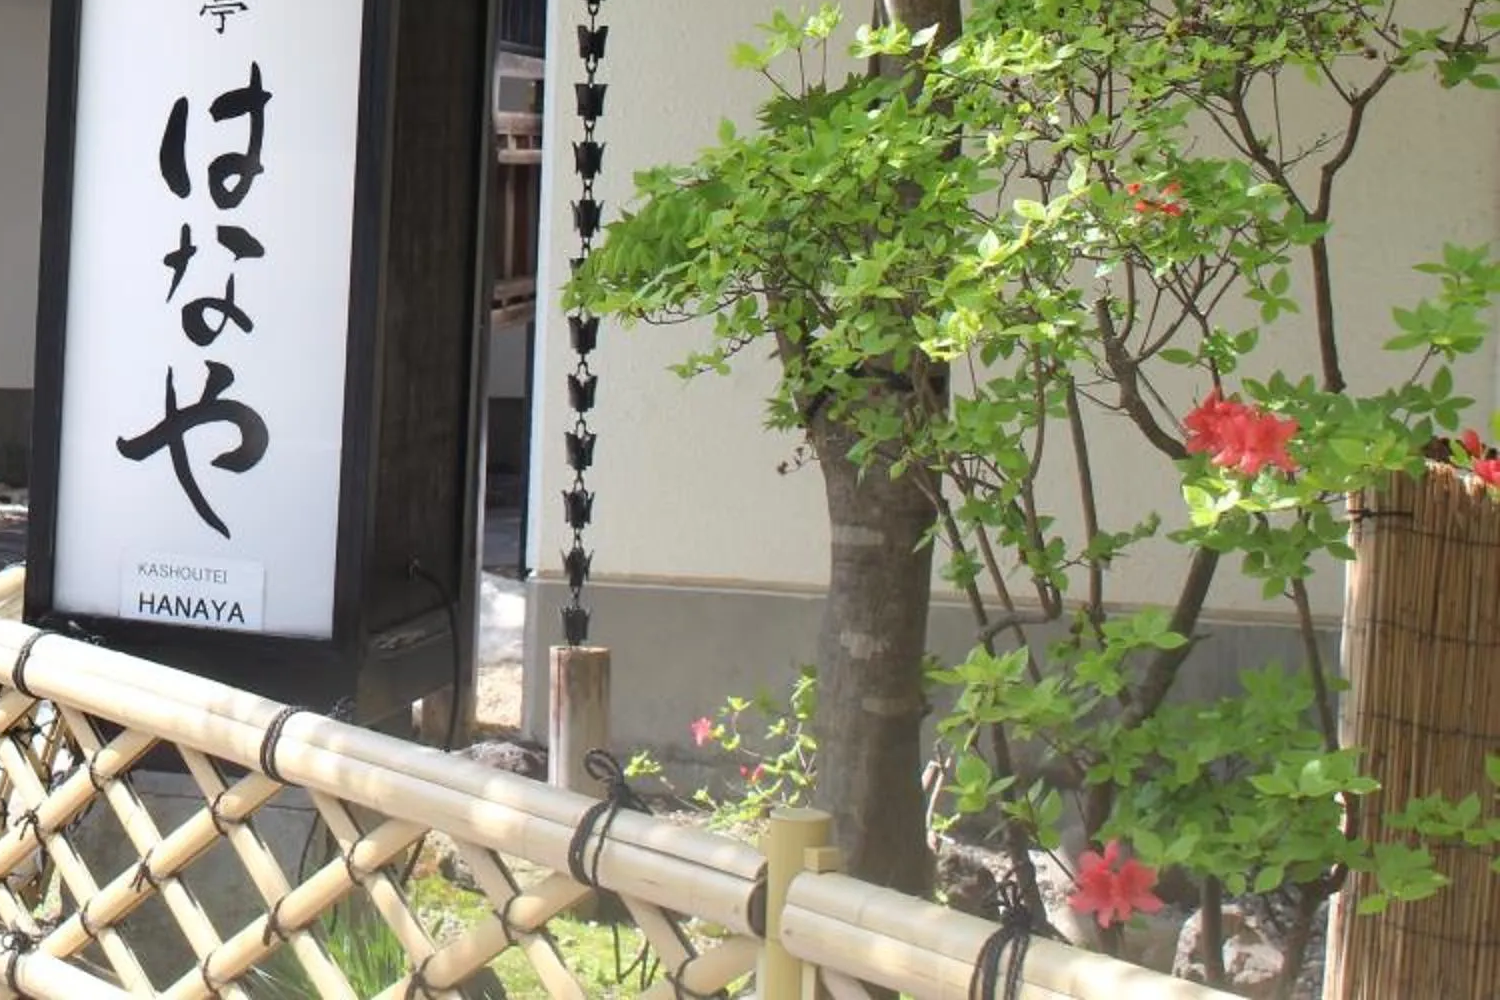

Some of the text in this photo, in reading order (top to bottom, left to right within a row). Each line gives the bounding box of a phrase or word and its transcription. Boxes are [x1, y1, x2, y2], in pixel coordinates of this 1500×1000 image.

[115, 61, 273, 539] はなや
[137, 562, 228, 584] KASHOUTEI
[138, 591, 246, 624] HANAYA
